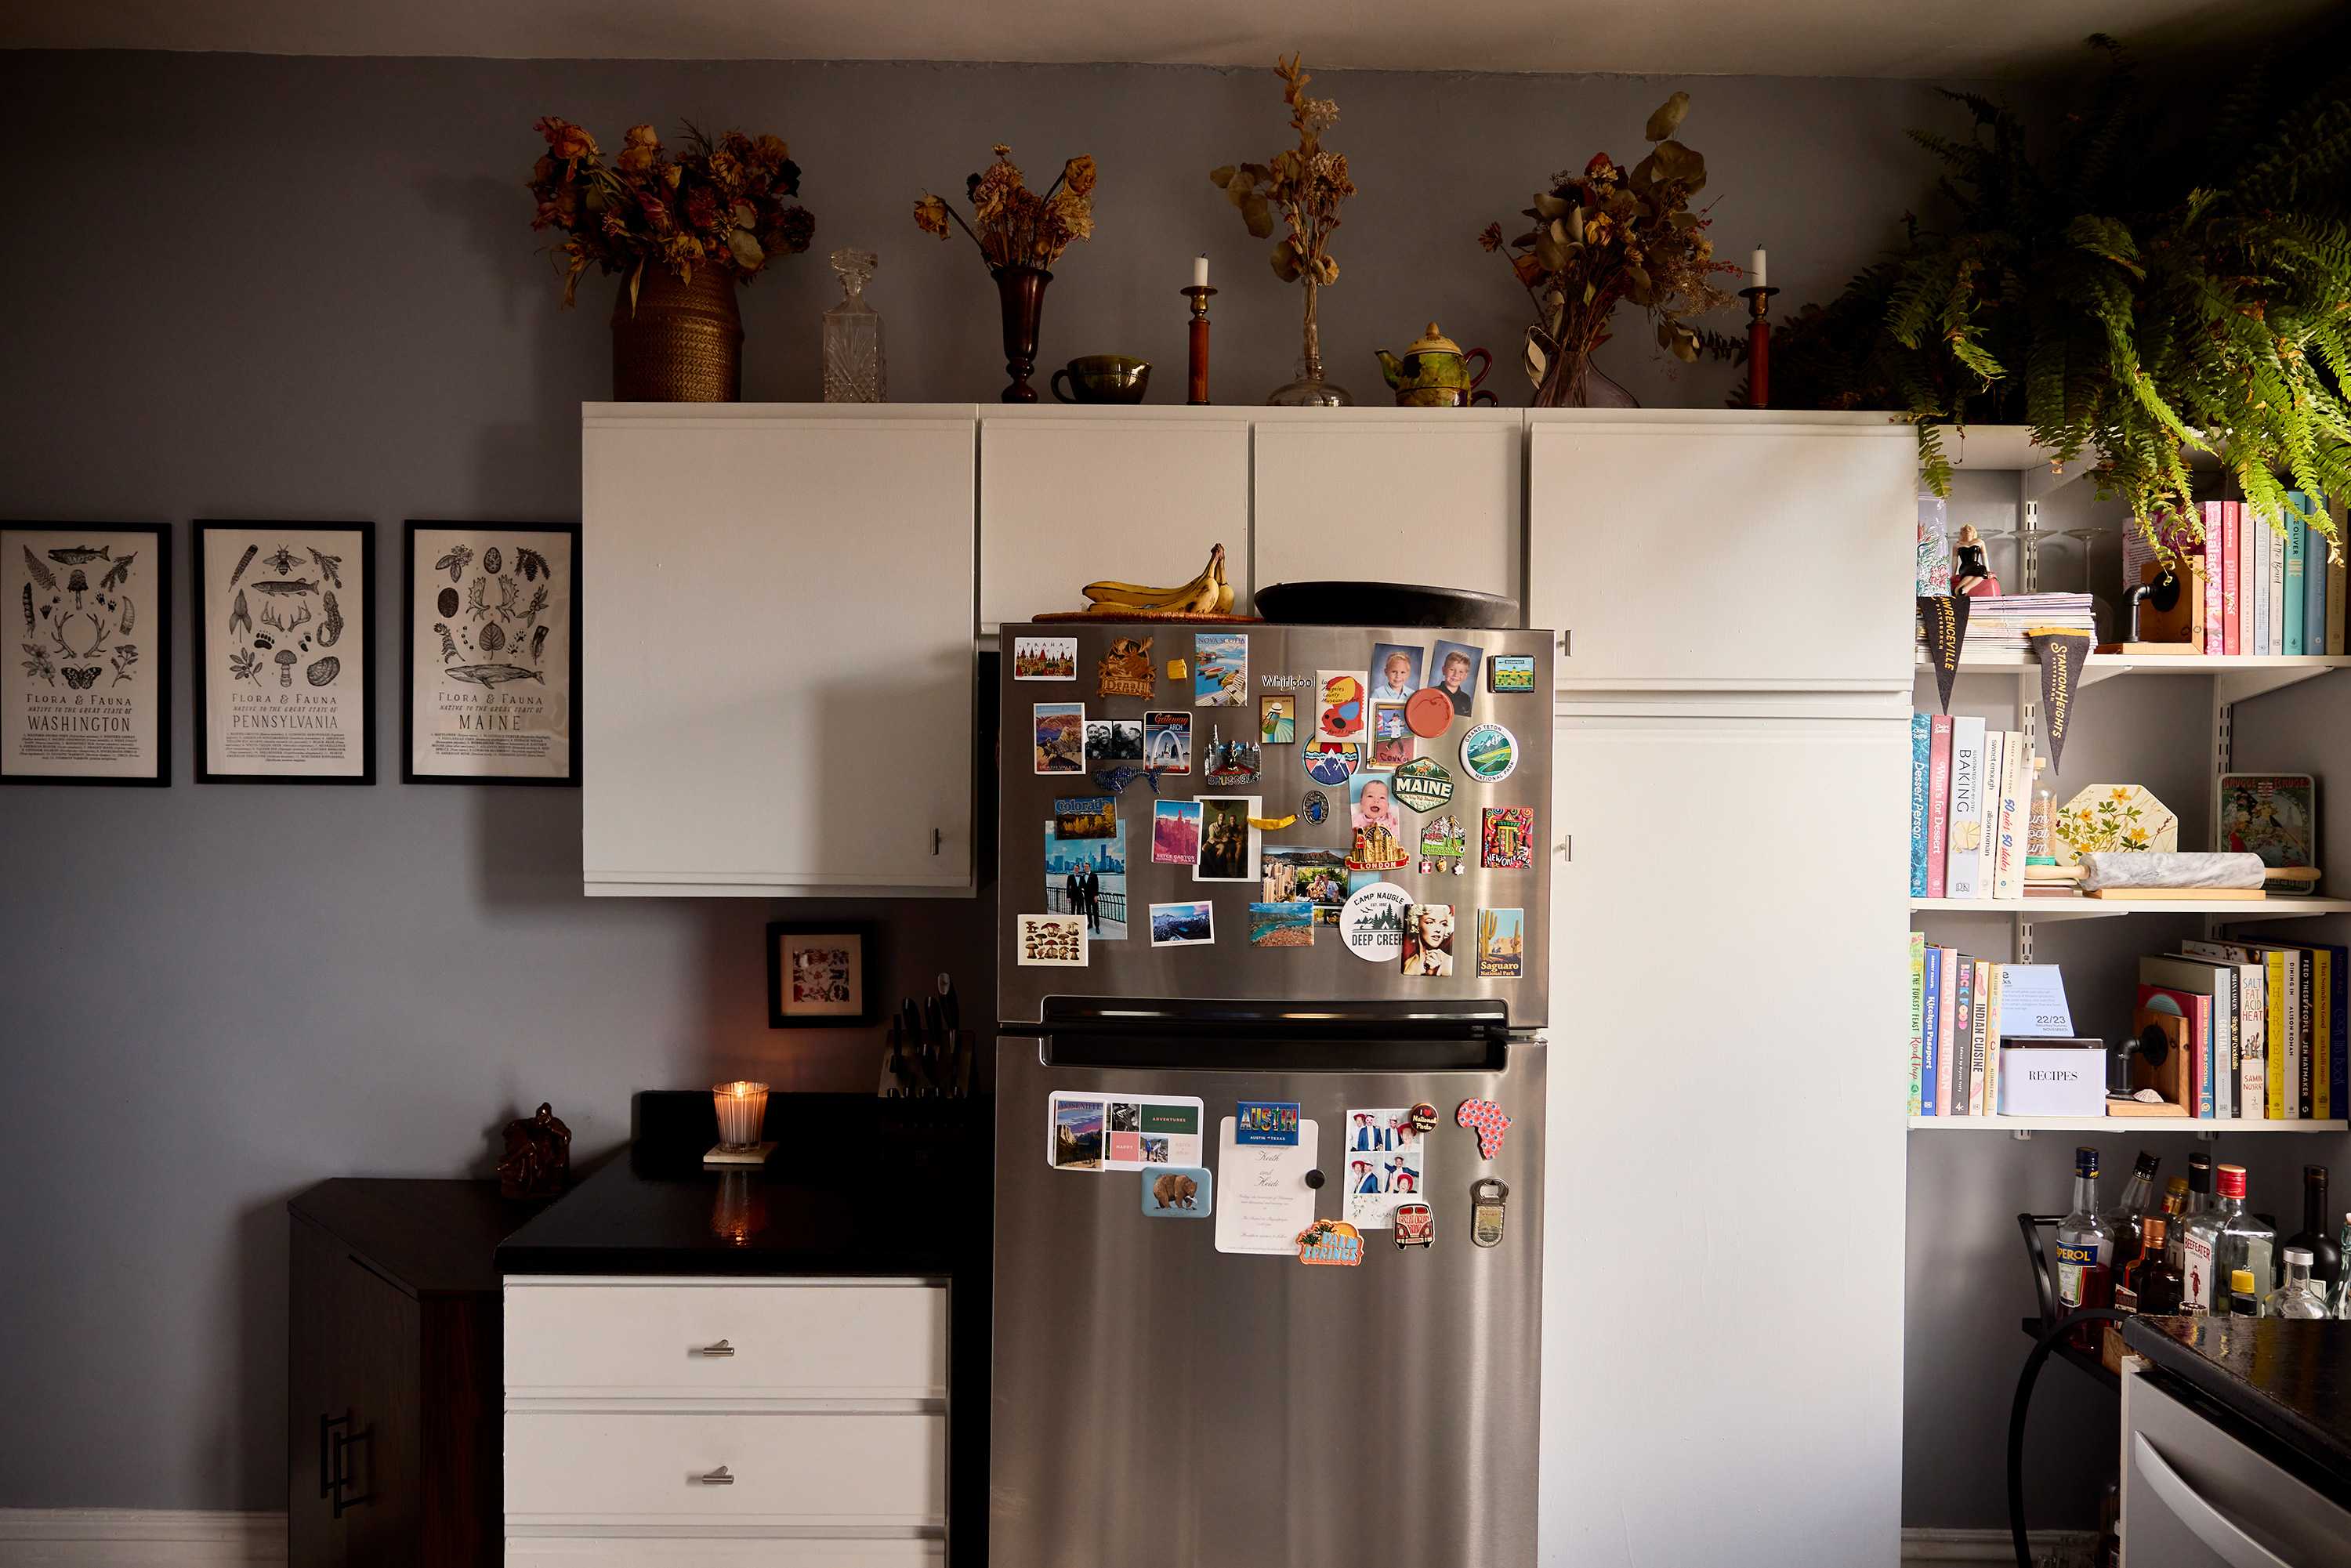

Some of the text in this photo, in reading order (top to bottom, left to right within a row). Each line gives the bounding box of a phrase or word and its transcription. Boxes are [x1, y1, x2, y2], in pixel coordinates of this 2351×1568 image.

[1935, 603, 1944, 650] PITTSBURGH
[1261, 674, 1316, 690] Whirlpool
[74, 694, 84, 705] &
[280, 694, 289, 704] &
[486, 693, 495, 704] &
[27, 715, 130, 732] WASHINGTON
[233, 715, 339, 729] PENNSYLVANIA
[459, 714, 521, 731] MAINE
[1154, 712, 1189, 726] Gateway
[1465, 726, 1482, 743] GRAND
[1208, 771, 1260, 786] BRUSSELS
[1474, 761, 1515, 782] NATIONAL PARK
[1396, 777, 1453, 798] MAINE
[1957, 749, 1972, 812] BAKING
[1912, 761, 1925, 839] Dessert Person
[1934, 800, 1944, 815] for
[2004, 798, 2015, 813] 50
[1933, 817, 1944, 854] Dessert
[2001, 834, 2013, 847] 50
[1360, 861, 1396, 870] LONDON
[1487, 853, 1531, 867] NEW ORLEANS
[1956, 883, 1970, 892] DK
[1353, 892, 1405, 906] CAMP NAUGLE
[1352, 934, 1374, 947] DEEP
[1480, 961, 1519, 972] Saguaro
[2243, 977, 2262, 989] SALT
[1958, 964, 1970, 1030] BLACK FOOD
[2245, 989, 2259, 1000] FAT
[2244, 1000, 2262, 1011] ACID
[1941, 957, 1955, 1090] KOREAN AMERICAN
[2242, 1010, 2263, 1022] HEAT
[1925, 996, 1935, 1070] Kitchen Passport
[1972, 1003, 1986, 1073] INDIAN CUISINE
[2272, 987, 2281, 1083] HARVEST
[1910, 1036, 1922, 1060] Road
[2332, 1009, 2346, 1085] COOK THIS BOOK
[1909, 1063, 1922, 1080] Trip
[2029, 1070, 2078, 1081] RECIPES
[1240, 1106, 1298, 1132] AUSTIN
[1412, 1114, 1437, 1124] National
[1398, 1215, 1414, 1223] GREAT
[1414, 1215, 1430, 1223] OCEAN
[1322, 1231, 1358, 1248] PALM
[1303, 1245, 1357, 1262] SPRINGS
[2185, 1237, 2211, 1262] BEEFEATER
